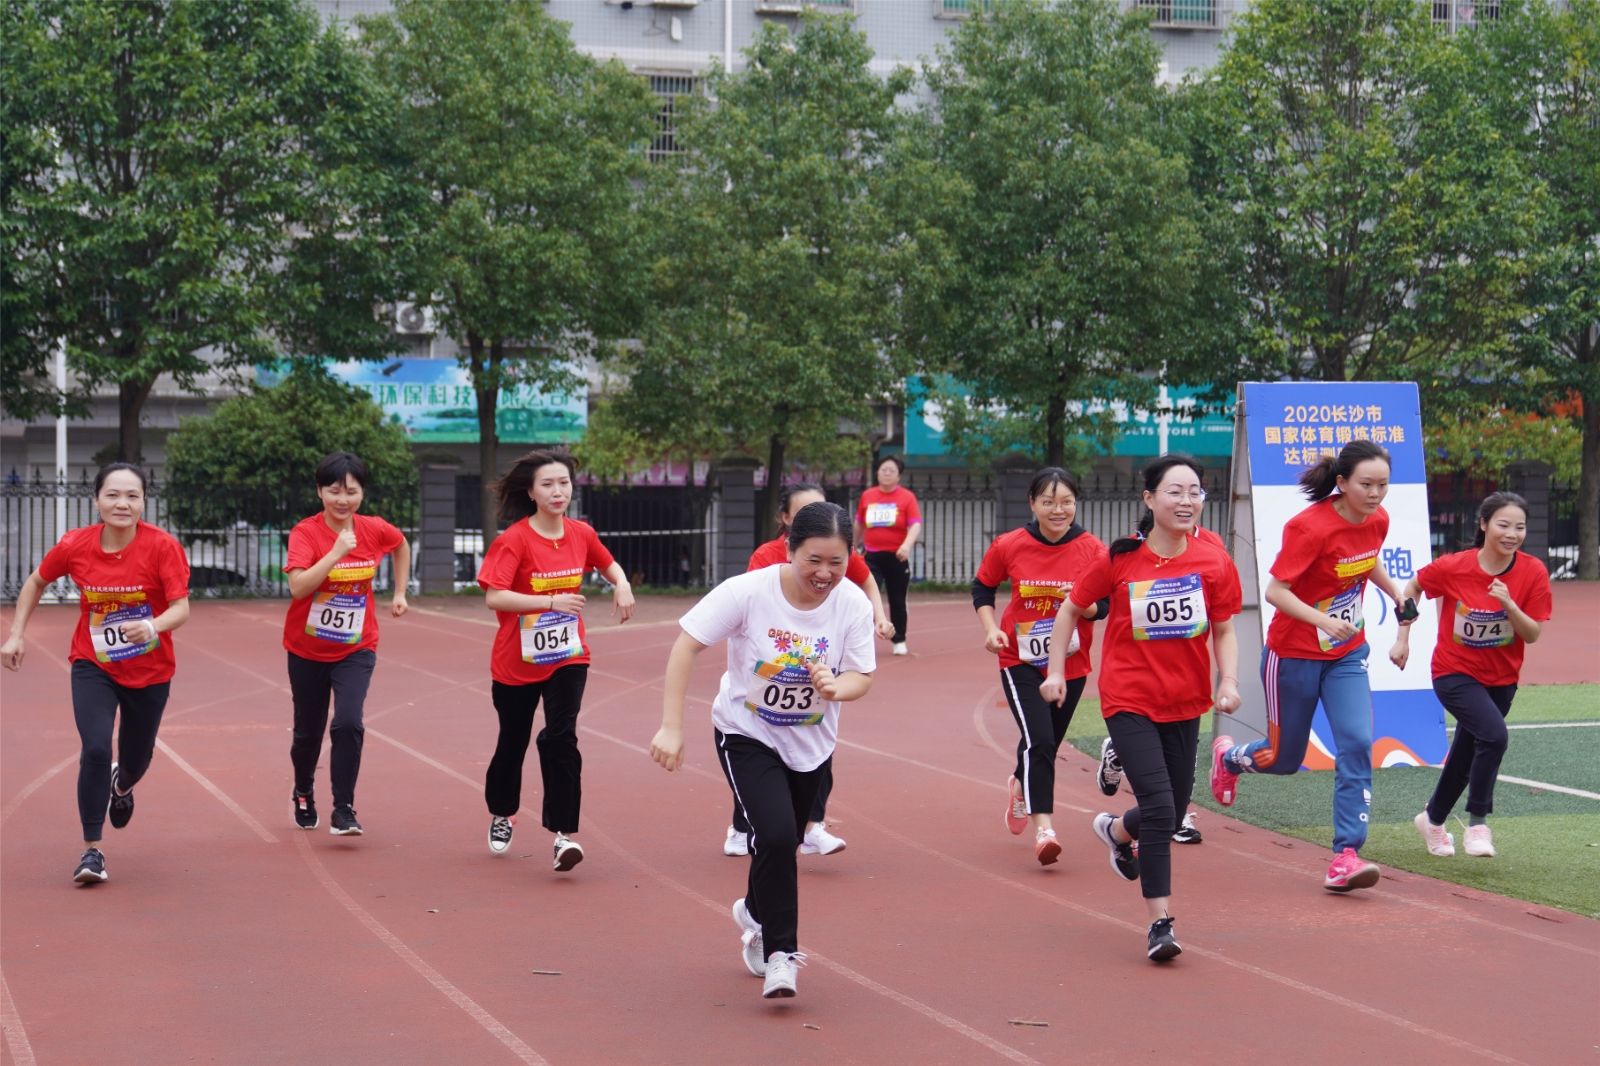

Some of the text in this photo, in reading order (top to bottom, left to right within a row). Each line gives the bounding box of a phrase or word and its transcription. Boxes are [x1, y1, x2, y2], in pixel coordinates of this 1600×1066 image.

[1284, 405, 1382, 423] 2020长沙市
[1264, 426, 1405, 444] 国家体育锻炼标准
[320, 608, 355, 630] 051
[1146, 597, 1193, 623] 055
[534, 626, 569, 651] 054
[1463, 622, 1502, 638] 074
[763, 684, 814, 710] 053
